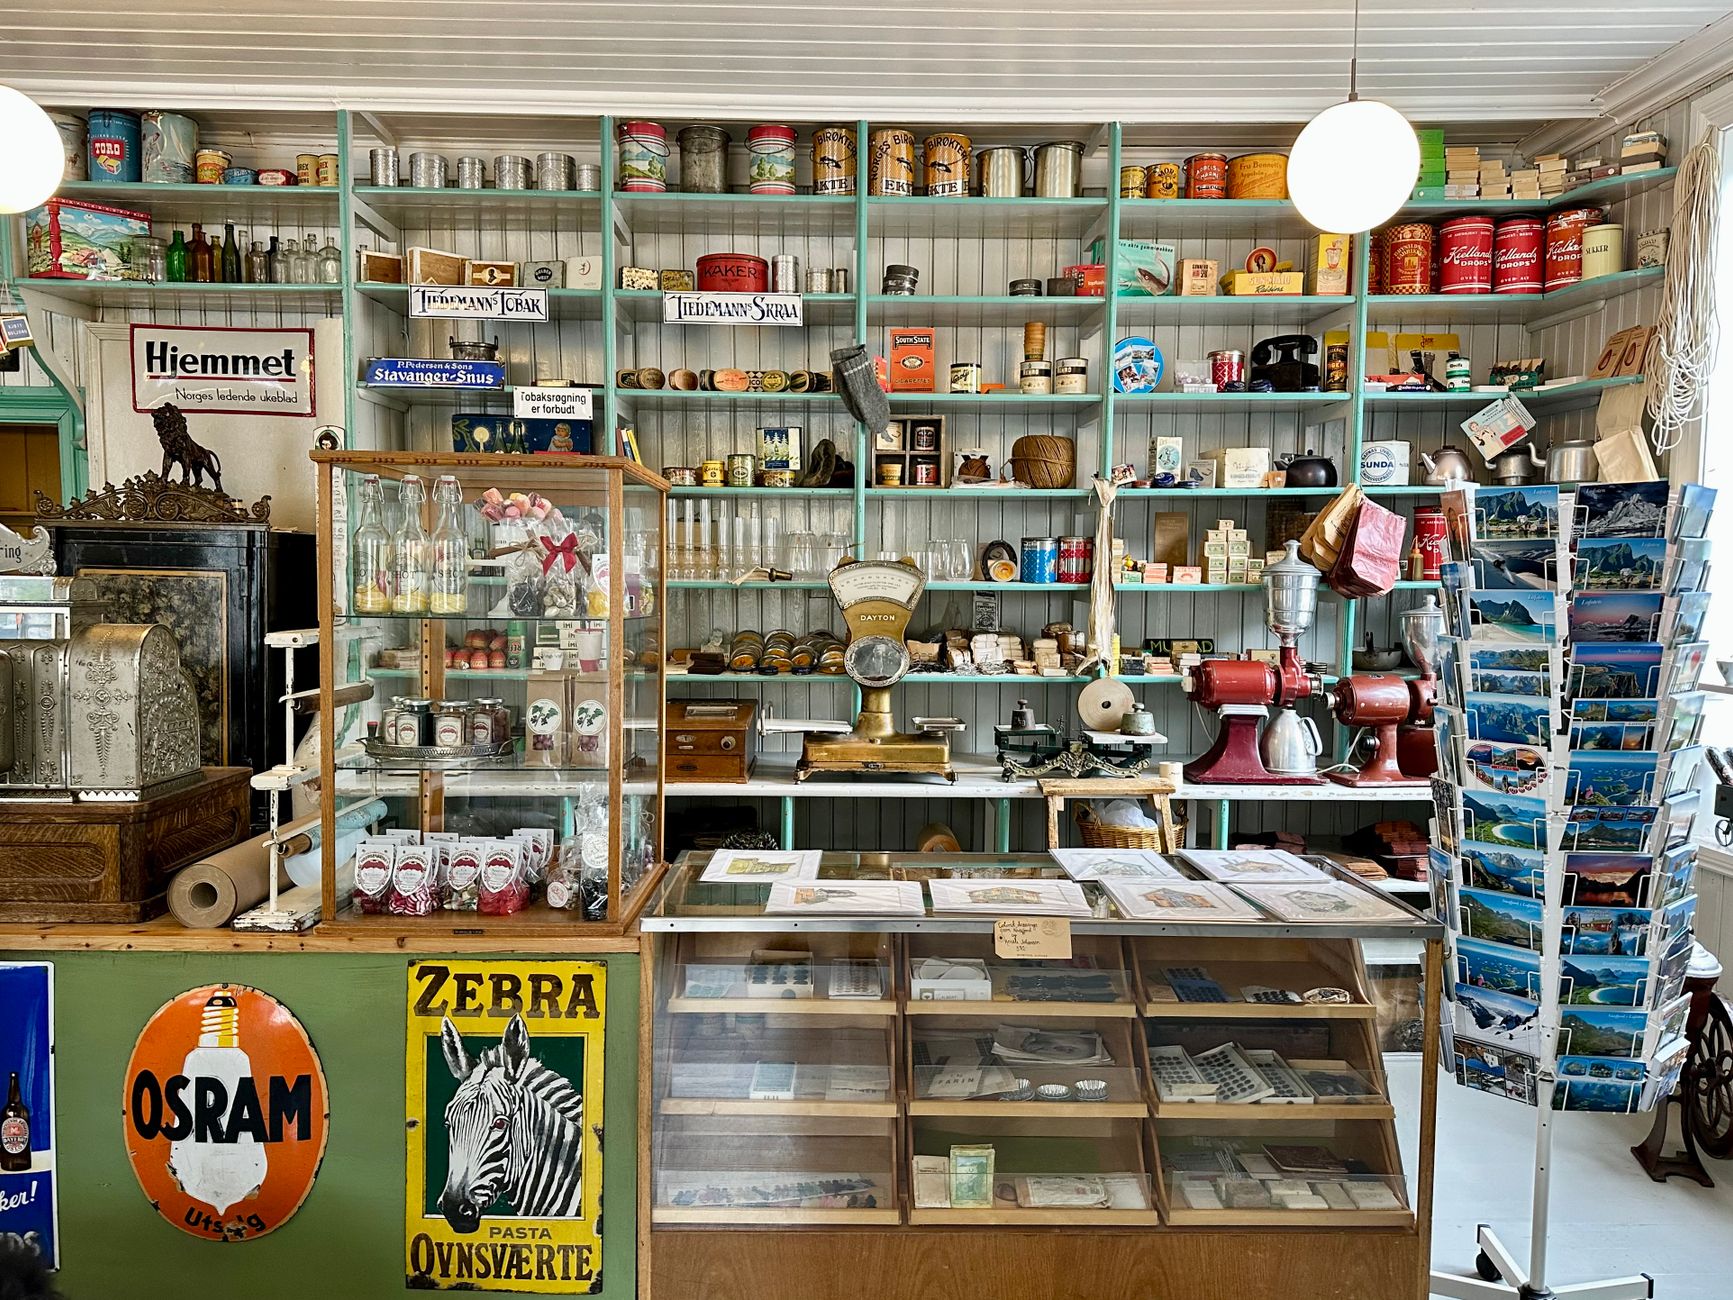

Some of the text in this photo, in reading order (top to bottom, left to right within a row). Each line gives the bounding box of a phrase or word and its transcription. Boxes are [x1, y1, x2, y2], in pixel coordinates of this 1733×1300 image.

[94, 142, 121, 156] TORO
[871, 140, 891, 181] NORGES
[1585, 244, 1609, 255] SUKKER
[703, 265, 758, 278] KAKER
[1501, 260, 1531, 269] DROPS
[1255, 284, 1284, 293] Raisins
[491, 289, 544, 316] TOBAK
[750, 295, 799, 322] SKRAA
[895, 335, 930, 344] SOUTH STATE
[145, 341, 297, 379] Hjemmet
[444, 361, 451, 369] &
[373, 368, 494, 386] Stavanger-Snus
[174, 387, 298, 404] Norges ledende ukeblad
[520, 391, 587, 405] Tobaksrøgning
[542, 404, 576, 415] forbudt
[1360, 461, 1394, 469] SUNDA
[1150, 639, 1214, 653] MUAD
[413, 965, 601, 1020] ZEBRA
[131, 1069, 313, 1144] OSRAM
[184, 1206, 267, 1234] Utsg
[489, 1226, 552, 1240] PASTA
[410, 1233, 594, 1281] OVNSVÆRTE
